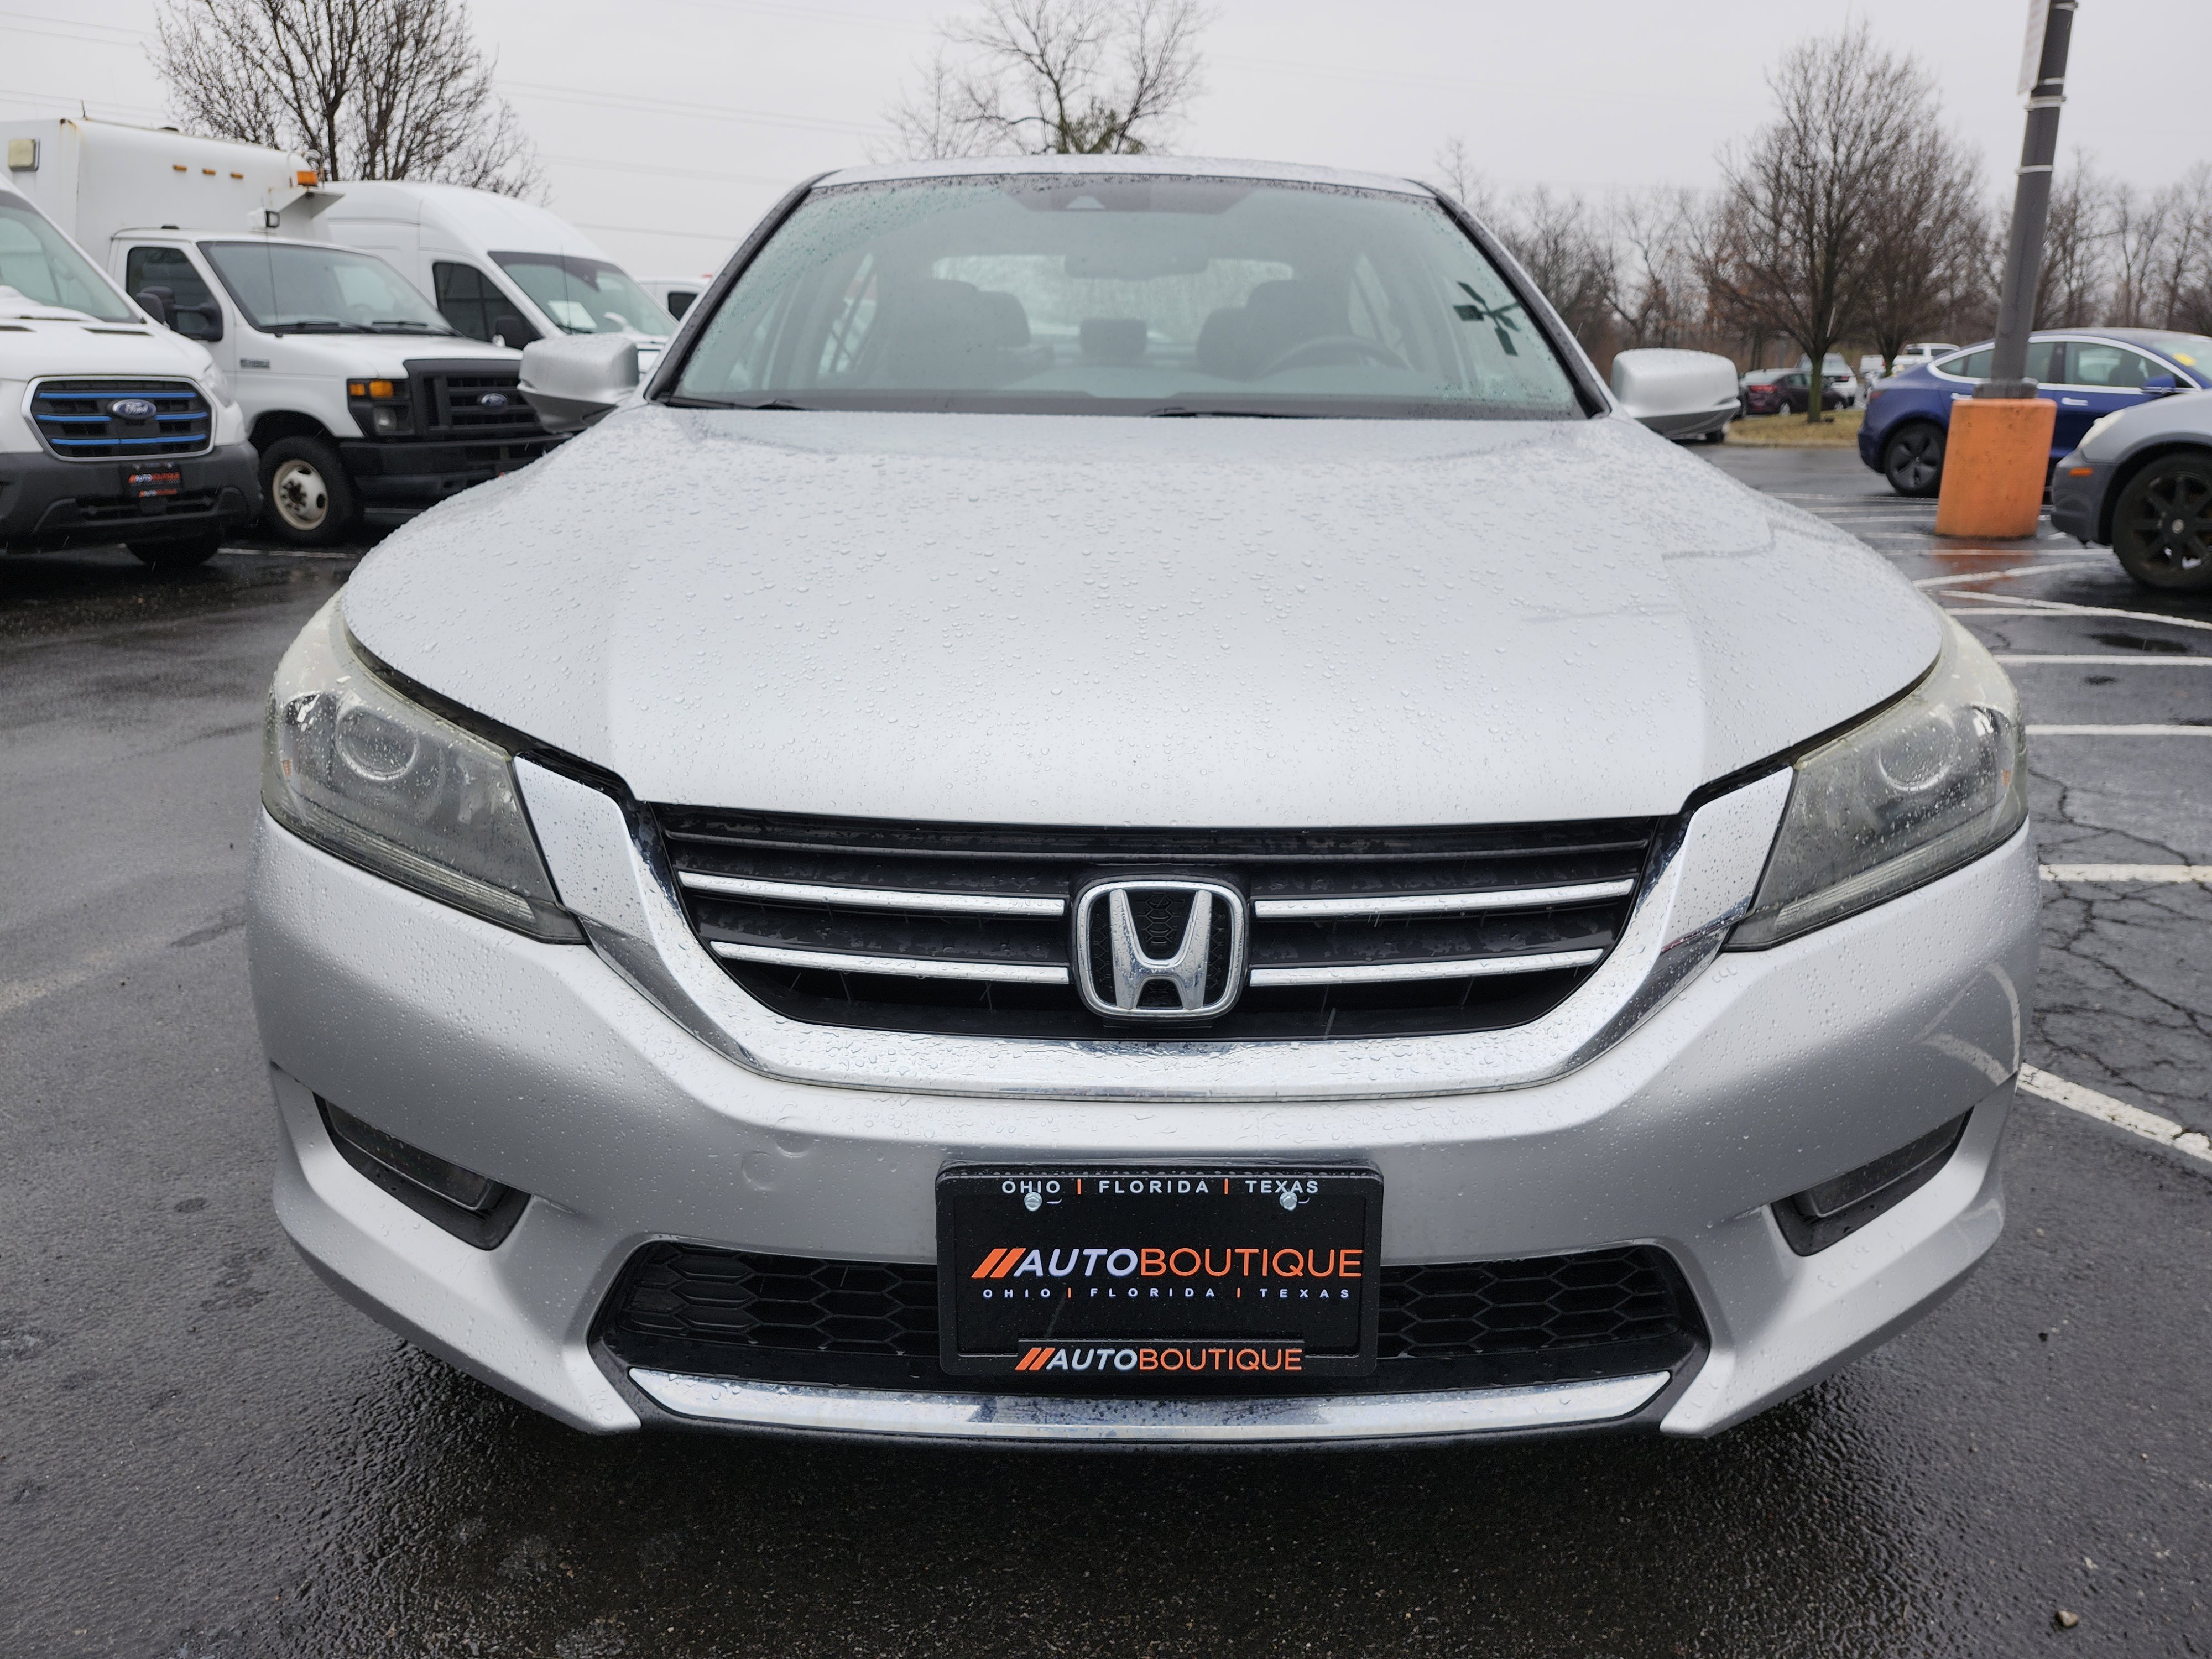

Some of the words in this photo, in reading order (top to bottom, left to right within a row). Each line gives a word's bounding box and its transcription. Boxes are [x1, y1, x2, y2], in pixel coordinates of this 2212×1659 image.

[1001, 1180, 1061, 1194] OHIO
[1099, 1180, 1209, 1194] FLORIDA
[1245, 1180, 1318, 1194] TEXAS
[1013, 1248, 1363, 1278] AUTOBOUTIQUE
[982, 1288, 1051, 1298] OHIO
[1090, 1287, 1215, 1298] FLORIDA
[1259, 1288, 1350, 1299] TEXAS
[1046, 1348, 1302, 1371] AUTOBOUTIQUE
